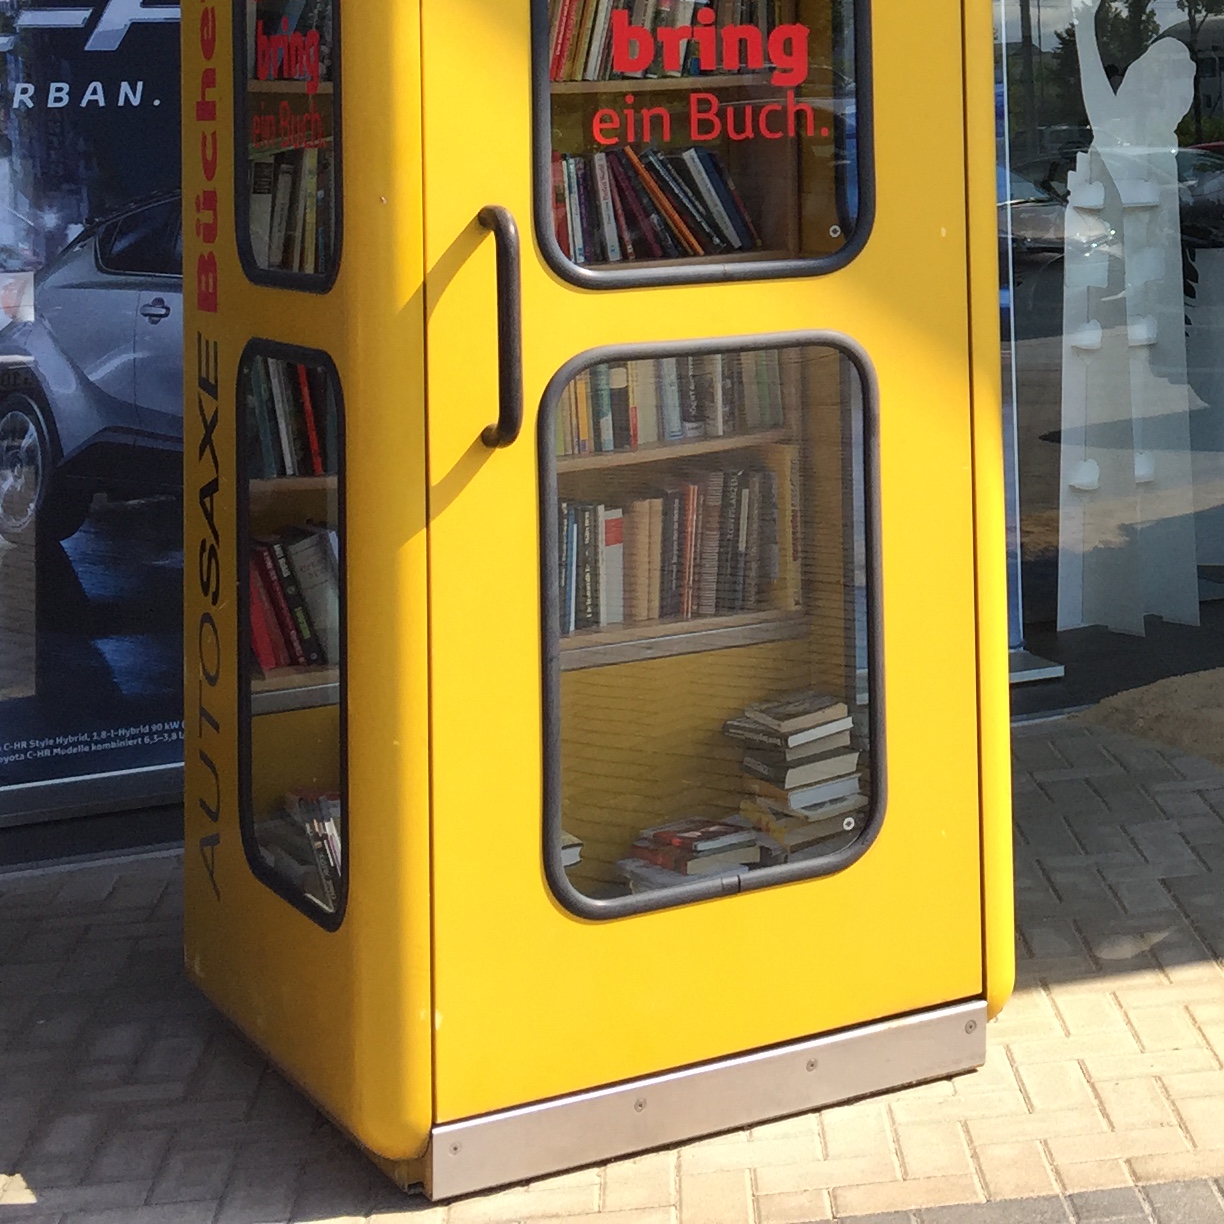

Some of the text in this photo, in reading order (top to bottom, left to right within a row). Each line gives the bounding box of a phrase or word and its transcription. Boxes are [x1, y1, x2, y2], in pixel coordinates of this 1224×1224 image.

[256, 16, 321, 95] bring
[610, 8, 811, 88] bring
[252, 101, 277, 149] ein
[591, 90, 831, 145] ein Buch.
[198, 330, 221, 903] AUTOSAXE
[3, 741, 27, 751] C-HR
[29, 738, 54, 749] Style
[164, 720, 180, 730] kW
[26, 748, 51, 759] C-HR
[52, 744, 90, 756] Modelle
[91, 737, 142, 751] kombiniert
